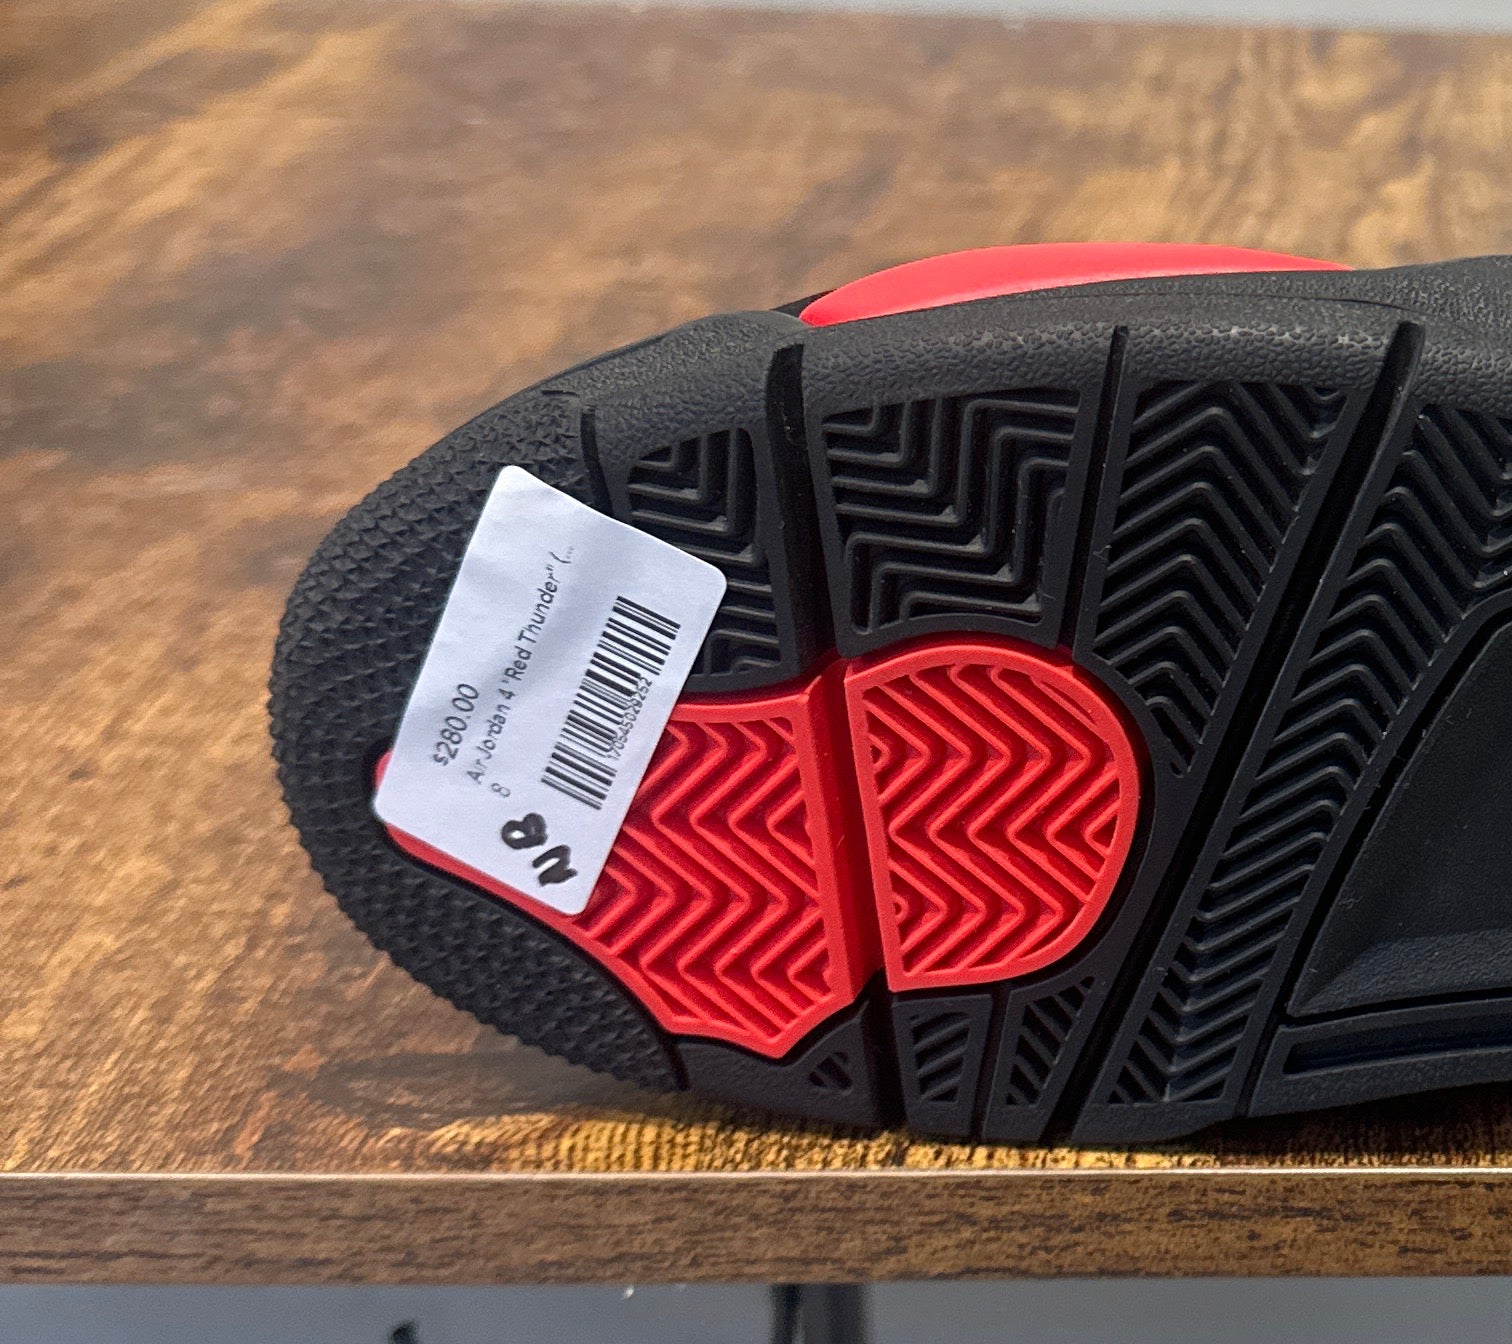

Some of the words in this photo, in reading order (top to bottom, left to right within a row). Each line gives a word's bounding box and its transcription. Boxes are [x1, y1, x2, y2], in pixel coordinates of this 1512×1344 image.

[433, 683, 480, 766] $280.00
[477, 705, 510, 760] Jordan
[498, 687, 516, 702] 4
[490, 782, 511, 798] 8
